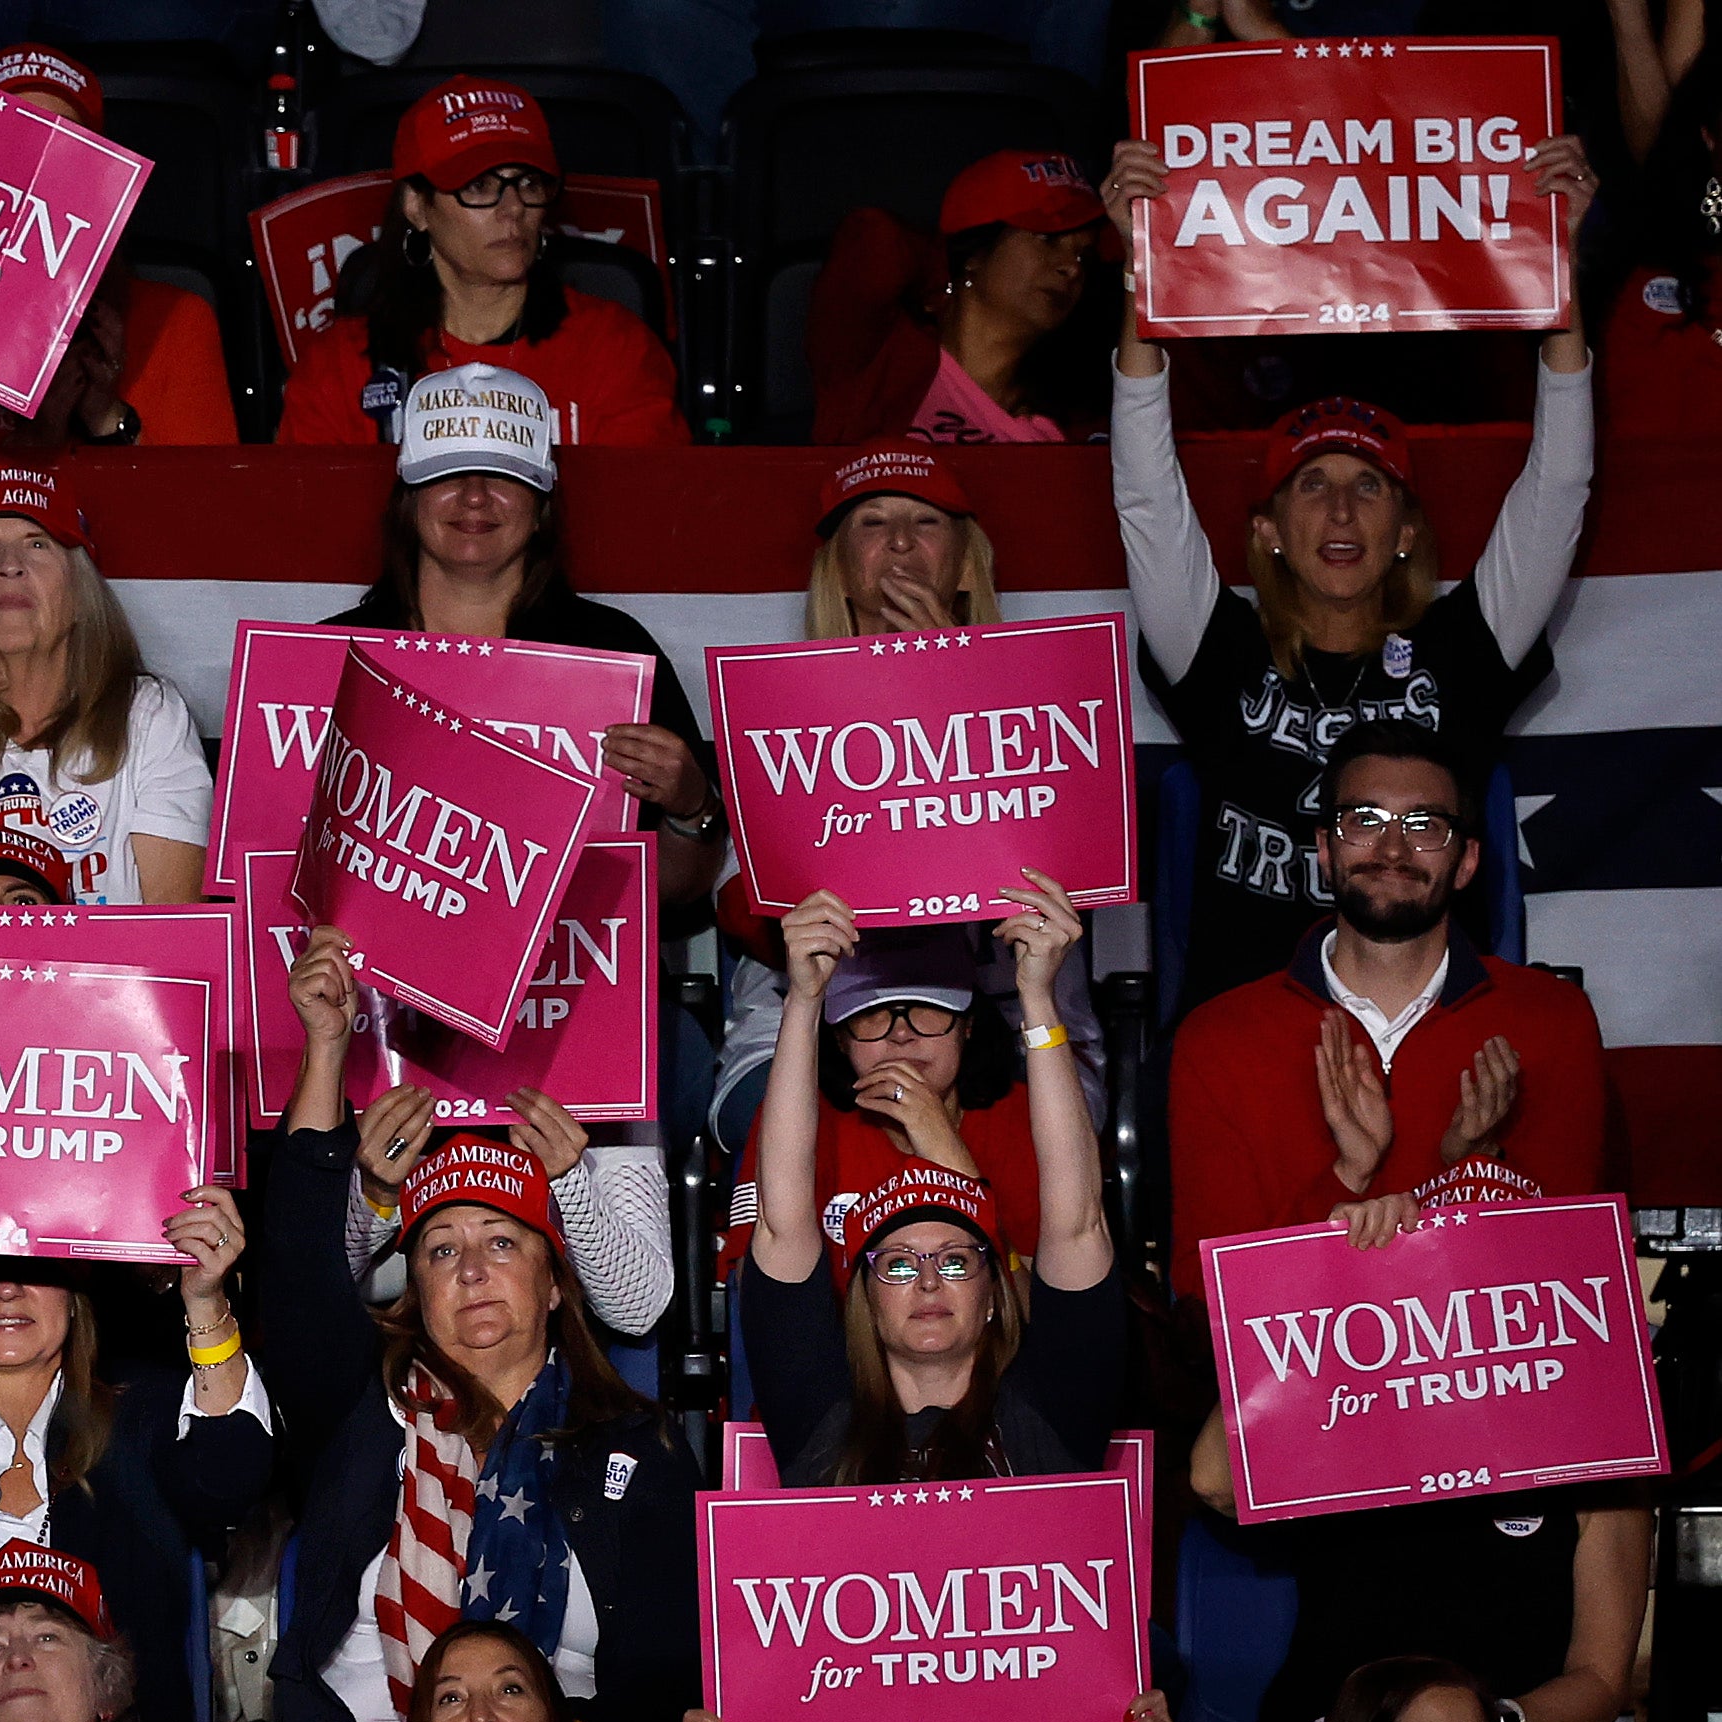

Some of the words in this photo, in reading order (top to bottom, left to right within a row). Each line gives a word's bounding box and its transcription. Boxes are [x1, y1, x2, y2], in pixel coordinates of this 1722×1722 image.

[1164, 120, 1393, 168] DREAM
[1415, 117, 1537, 162] BIG,
[1175, 175, 1516, 252] AGAIN!
[1318, 302, 1389, 324] 2024
[416, 388, 466, 416] MAKE
[467, 389, 545, 423] AMERICA
[422, 418, 480, 443] GREAT
[484, 419, 536, 449] AGAIN
[744, 700, 1102, 795] WOMEN
[50, 796, 88, 822] TEAM
[52, 802, 96, 834] TRUMP
[72, 824, 95, 841] 2024
[328, 718, 552, 913] WOMEN
[818, 804, 871, 847] for
[880, 786, 1055, 830] TRUMP
[333, 826, 470, 918] TRUMP
[909, 894, 980, 916] 2024
[405, 1156, 447, 1196] MAKE
[447, 1146, 534, 1178] AMERICA
[413, 1172, 467, 1212] GREAT
[467, 1173, 525, 1200] AGAIN
[1244, 1277, 1609, 1386] WOMEN
[1321, 1385, 1378, 1430] for
[1386, 1360, 1563, 1409] TRUMP
[1420, 1468, 1491, 1493] 2024
[1505, 1522, 1530, 1532] 2024
[733, 1559, 1113, 1647] WOMEN
[801, 1657, 862, 1702] for
[872, 1646, 1056, 1685] TRUMP
